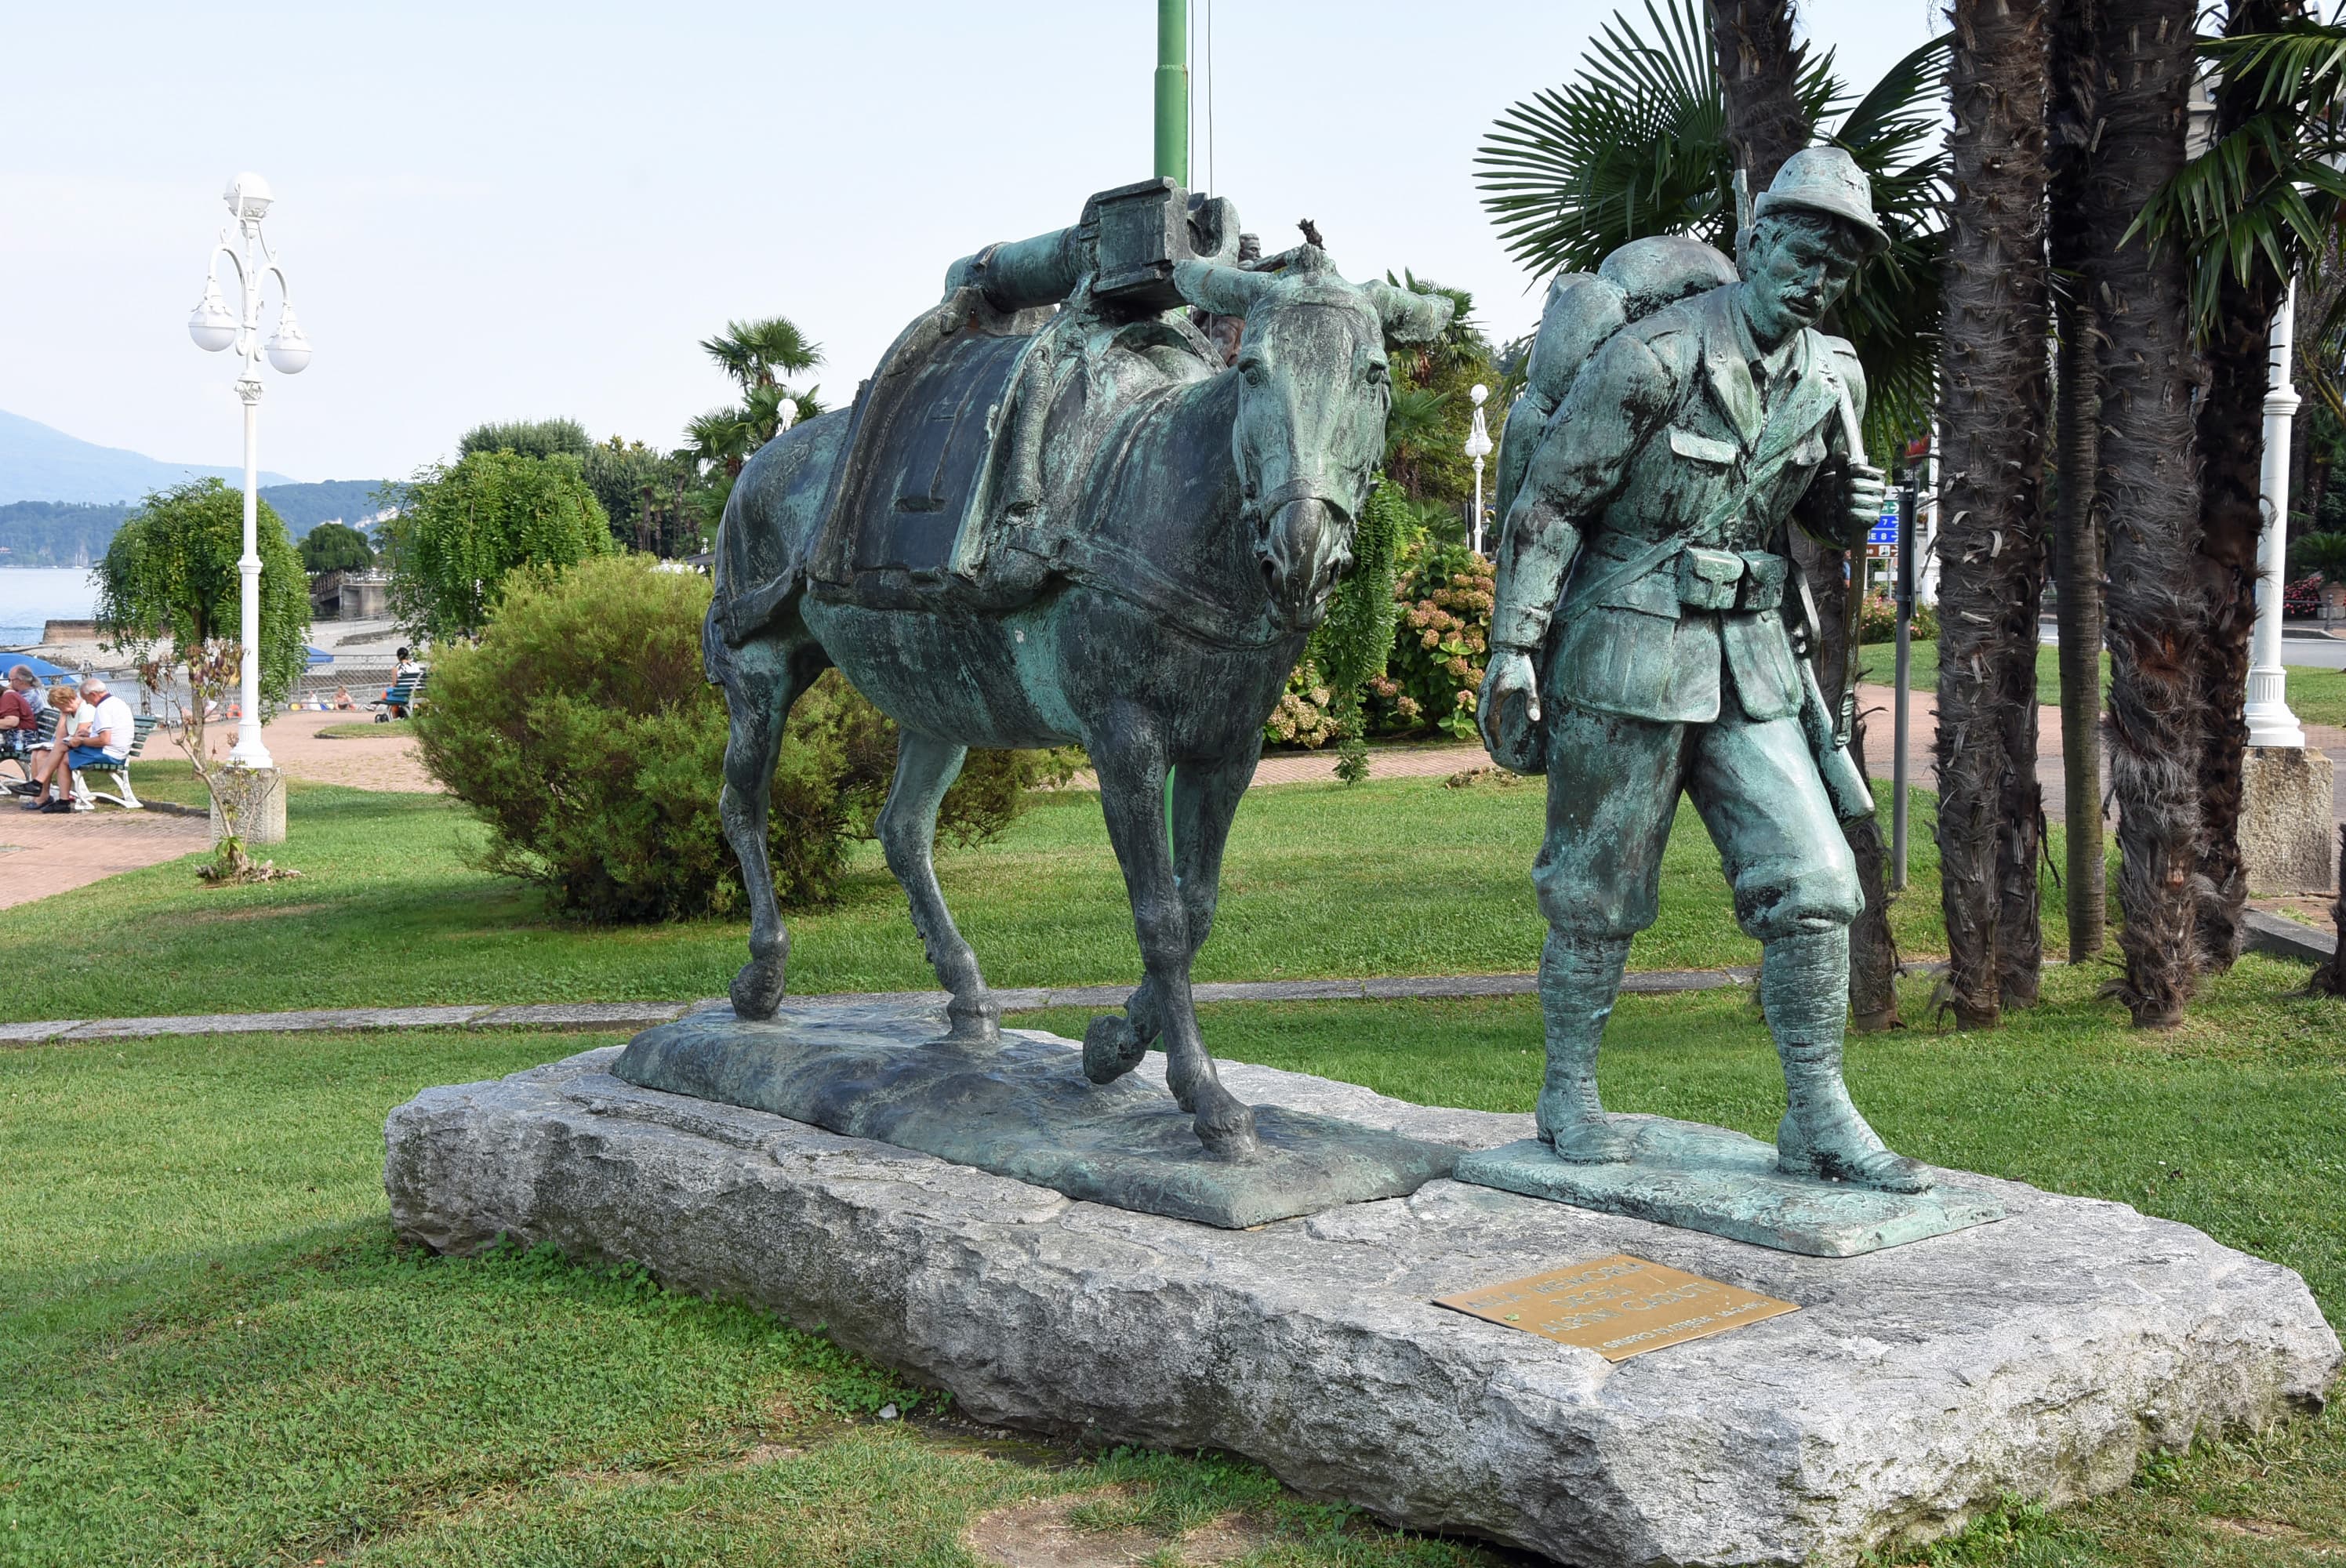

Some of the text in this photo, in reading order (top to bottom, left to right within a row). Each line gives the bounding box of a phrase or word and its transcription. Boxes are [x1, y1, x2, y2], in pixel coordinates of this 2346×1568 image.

[1465, 1261, 1651, 1311] ALLA MEMORIA
[1549, 1284, 1635, 1309] DEGLI
[1539, 1282, 1720, 1334] ALPINI CADUTI
[1603, 1331, 1658, 1349] GRUPPO
